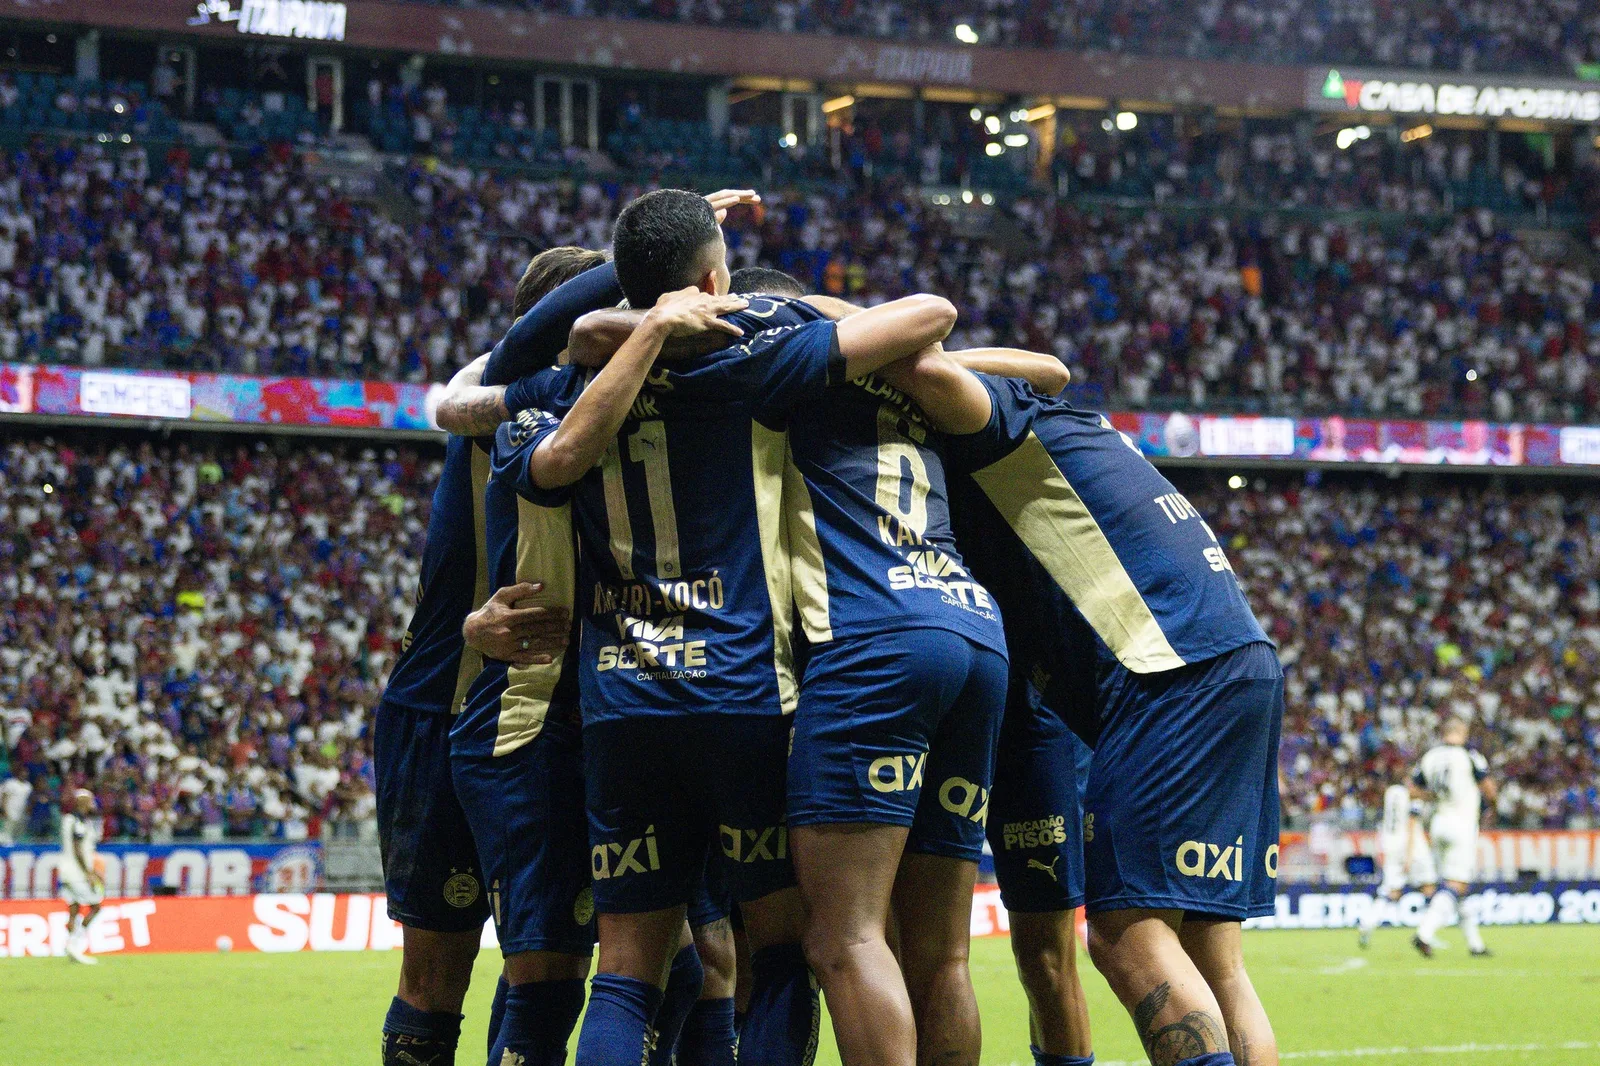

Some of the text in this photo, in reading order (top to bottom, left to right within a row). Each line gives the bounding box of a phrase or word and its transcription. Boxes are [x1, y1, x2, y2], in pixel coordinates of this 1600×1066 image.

[1359, 80, 1434, 113] CASA
[1437, 84, 1477, 115] DE
[616, 614, 684, 643] VIVA
[596, 640, 707, 672] SORTE
[636, 668, 707, 682] CAPITALIZAÇÃO
[1003, 814, 1065, 834] ATACADÃO
[1003, 826, 1067, 850] PISOS
[591, 824, 661, 881] axi
[1175, 835, 1243, 882] axi
